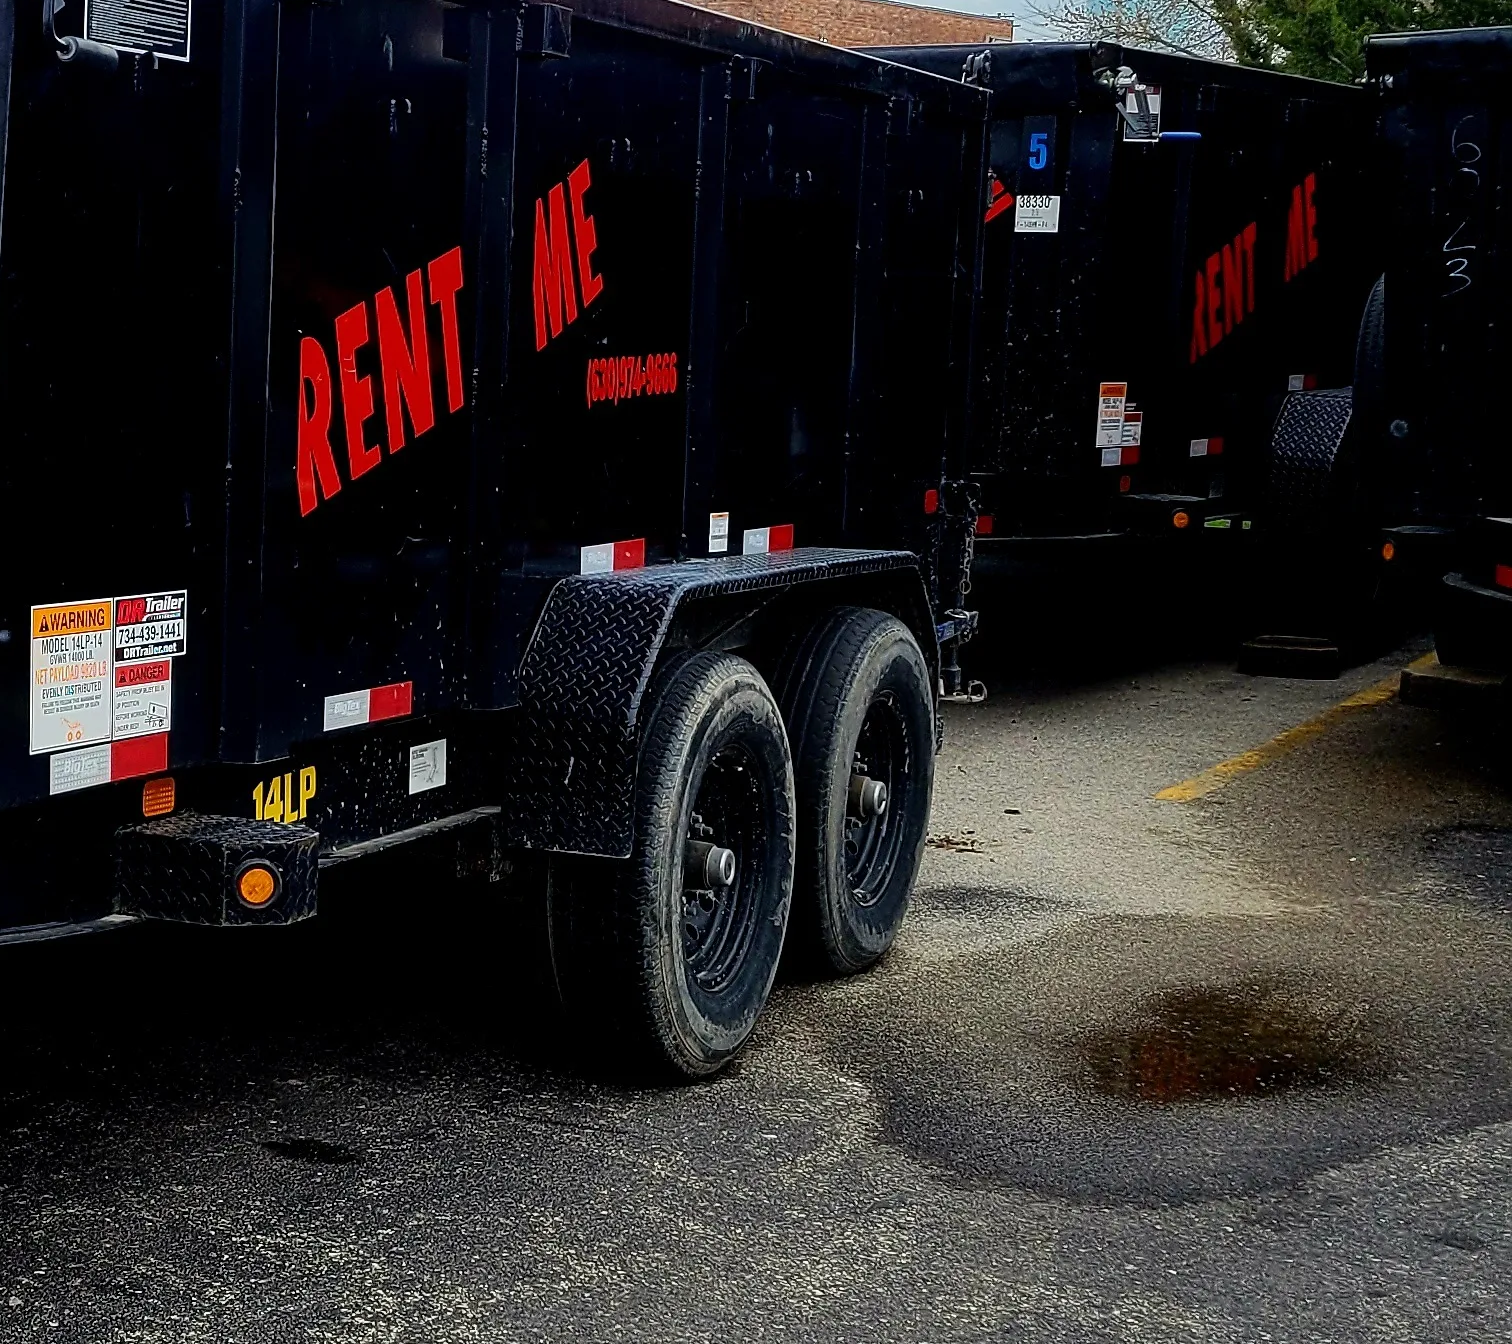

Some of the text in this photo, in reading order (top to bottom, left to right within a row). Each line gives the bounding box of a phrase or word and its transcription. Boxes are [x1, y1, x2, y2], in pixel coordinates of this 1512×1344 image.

[1029, 133, 1048, 169] 5
[1018, 195, 1052, 209] 38330
[1190, 172, 1319, 364] RENT ME
[296, 158, 603, 517] RENT ME
[145, 595, 185, 613] Trailer
[49, 608, 105, 632] WARNING
[41, 633, 103, 655] MODEL 14LP-14
[118, 621, 181, 645] 734-439-1441
[123, 642, 178, 659] DRTrailer.net
[49, 664, 79, 684] PAYLOAD
[128, 664, 164, 683] DANGER
[42, 681, 102, 700] EVENLY DISTRIBUTED
[252, 766, 317, 825] 14LP
